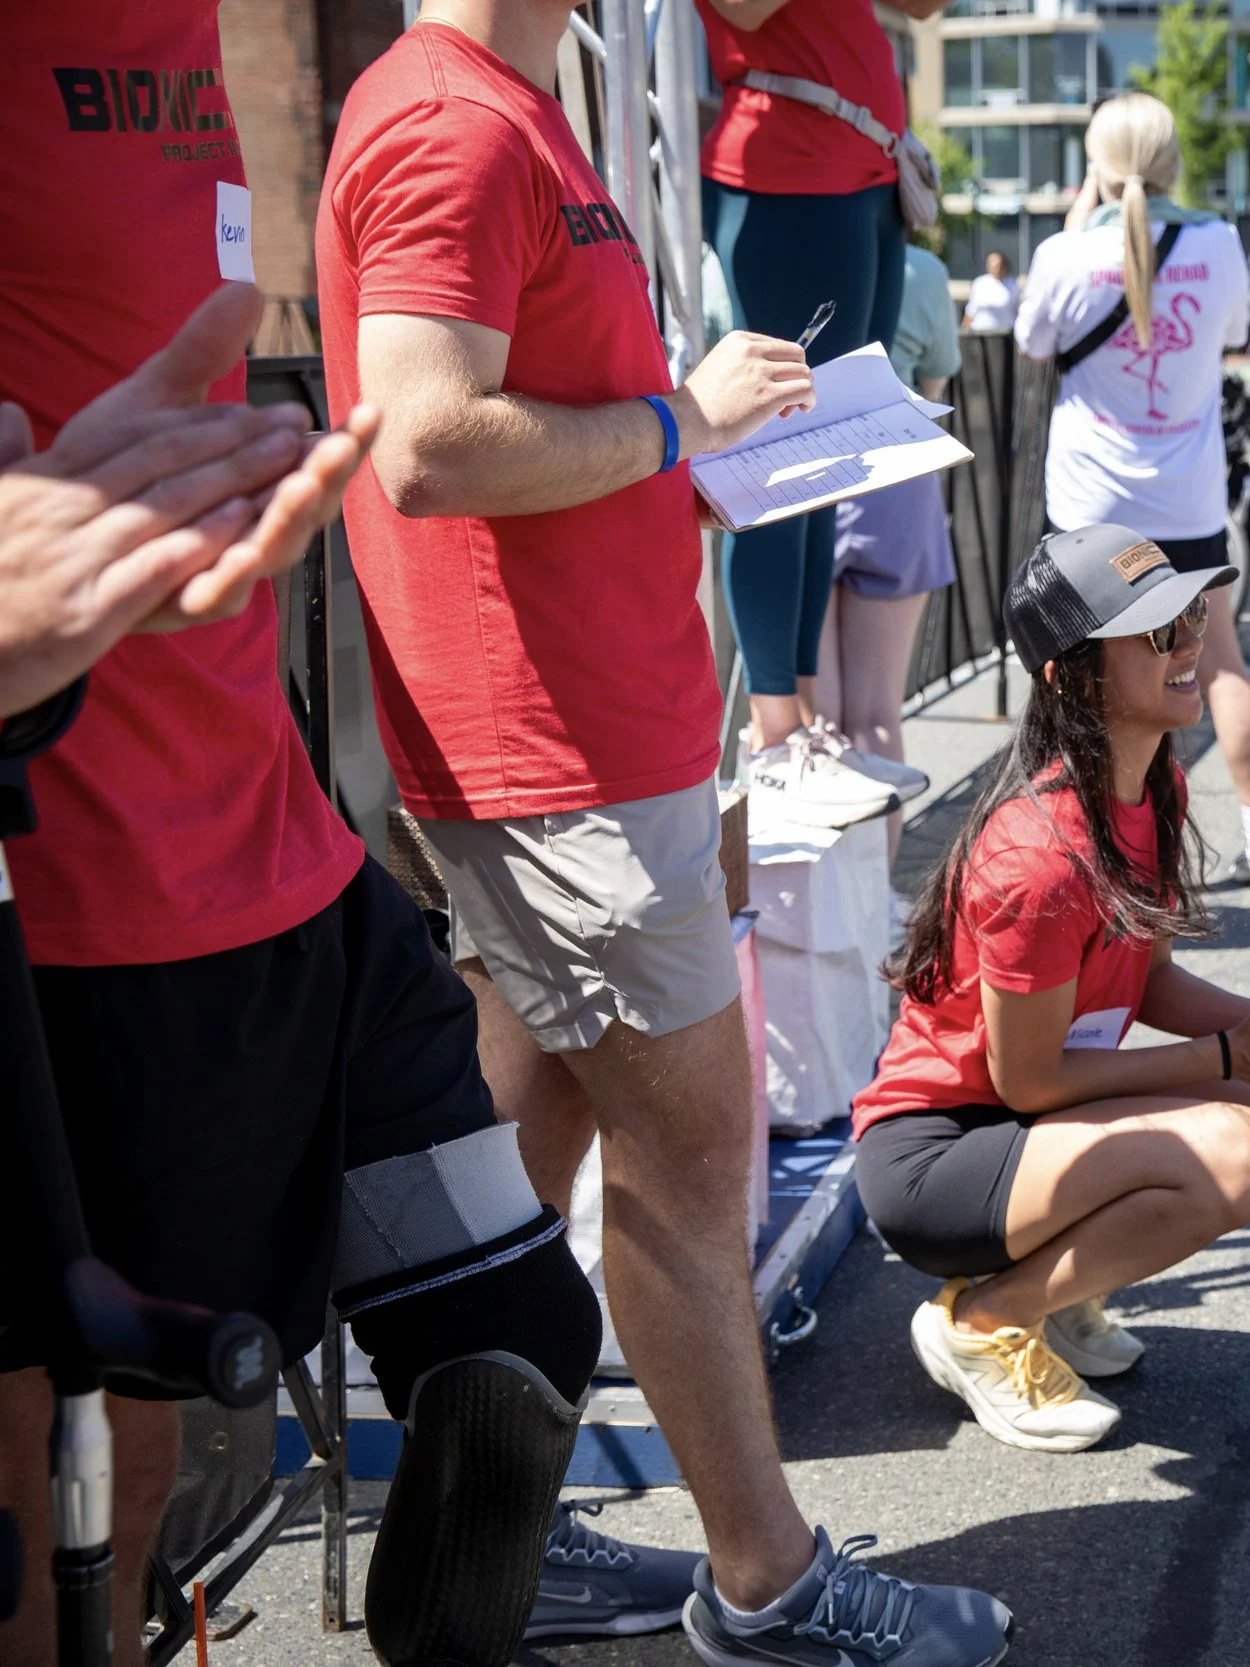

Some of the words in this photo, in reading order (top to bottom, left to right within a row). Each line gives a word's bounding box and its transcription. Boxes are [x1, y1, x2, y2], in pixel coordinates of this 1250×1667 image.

[51, 67, 234, 132] BIONIC
[161, 141, 226, 164] PROJECT
[754, 772, 786, 791] HOKA
